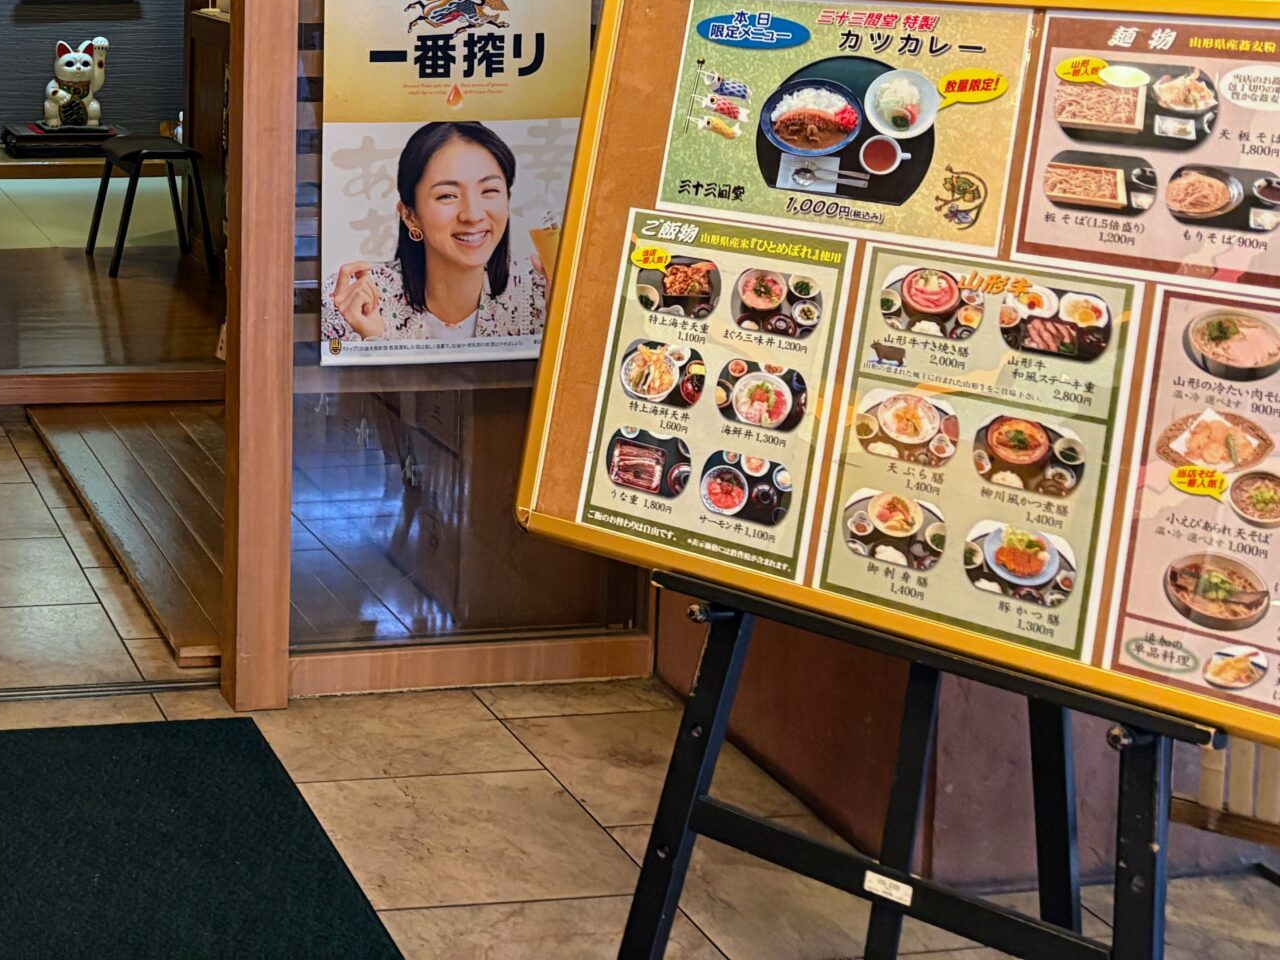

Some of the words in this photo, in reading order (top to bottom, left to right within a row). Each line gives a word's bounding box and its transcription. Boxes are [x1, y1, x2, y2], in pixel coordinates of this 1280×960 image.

[733, 10, 771, 26] 本日
[817, 9, 899, 30] 三十三間堂
[902, 14, 940, 31] 特製
[709, 24, 792, 43] 限定メニュー
[838, 29, 987, 56] カツカレー
[369, 32, 545, 78] 一番搾り
[1240, 143, 1280, 158] 1,800円
[640, 218, 700, 244] ご飯物
[1098, 230, 1136, 246] 1,200円
[1183, 230, 1235, 246] もりそば
[1237, 235, 1268, 251] 900円
[958, 270, 1034, 296] 山形牛
[648, 314, 710, 335] 特上海老天重
[677, 332, 706, 344] 1,100円
[777, 339, 808, 354] 1,200円
[929, 353, 966, 370] 2,000円
[1007, 355, 1047, 372] 山形牛
[1011, 368, 1096, 395] 和風ステーキ重
[1052, 389, 1092, 407] 2,800円
[1250, 403, 1280, 419] 900円
[659, 419, 688, 434] 1,600円
[721, 424, 754, 438] 海鮮丼
[754, 432, 786, 448] 1,300円
[904, 478, 940, 496] 1,400円
[610, 489, 639, 506] うな重
[642, 498, 673, 514] 1,800円
[698, 514, 744, 534] サーモン丼
[744, 526, 776, 544] 1,100円
[1025, 511, 1063, 529] 1,400円
[1227, 540, 1269, 560] 1,000円
[889, 582, 925, 601] 1,400円
[998, 600, 1060, 627] 豚かつ膳
[1016, 618, 1055, 638] 1,300円
[1144, 631, 1184, 650] 追加の
[1132, 642, 1191, 669] 単品料理
